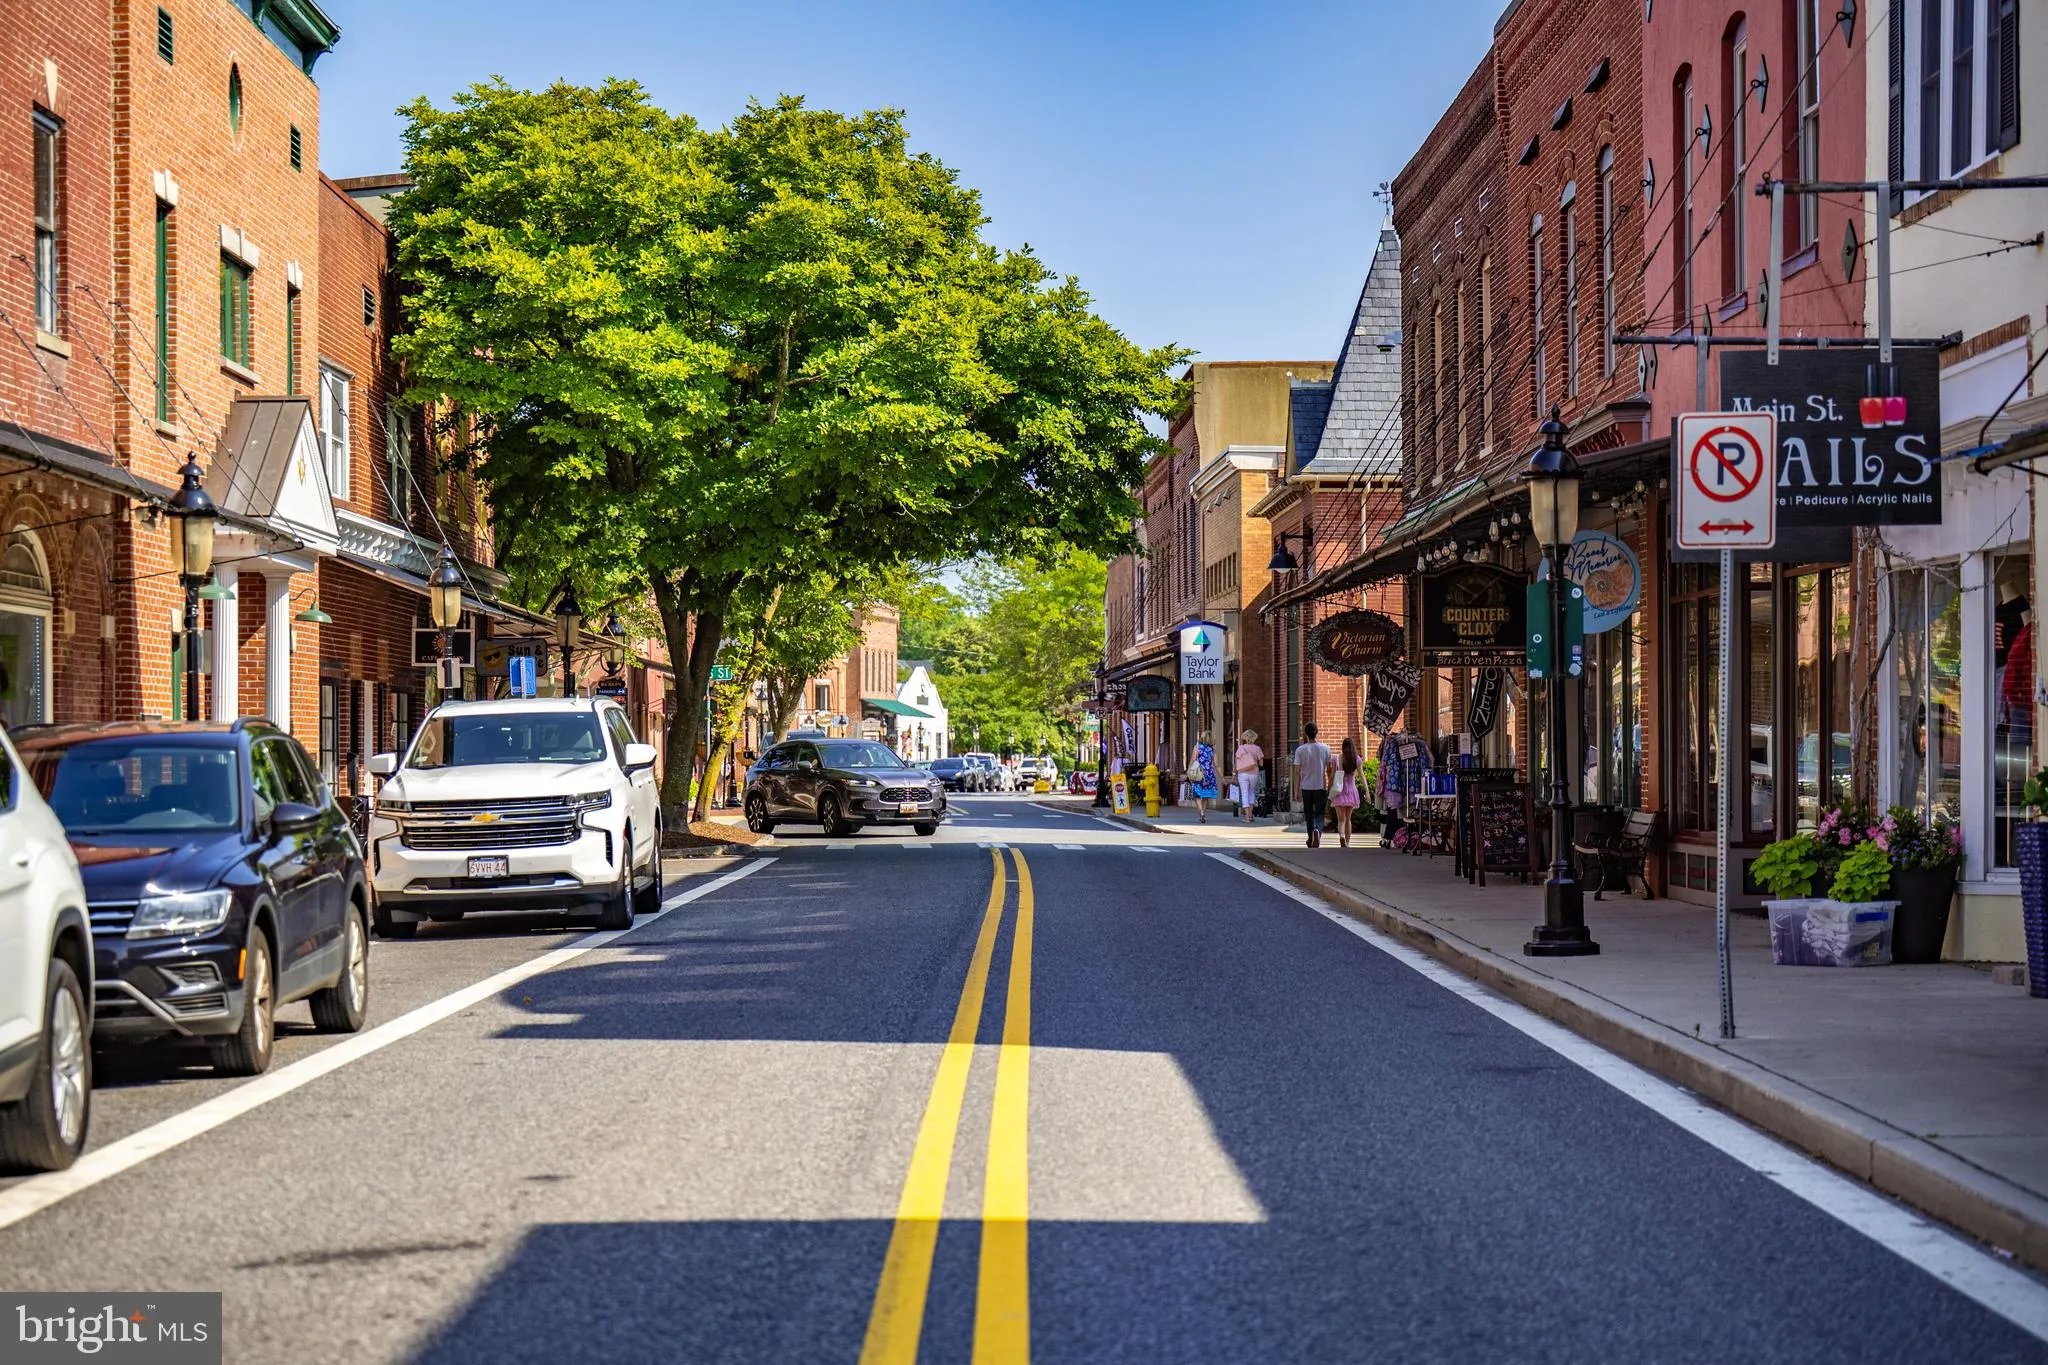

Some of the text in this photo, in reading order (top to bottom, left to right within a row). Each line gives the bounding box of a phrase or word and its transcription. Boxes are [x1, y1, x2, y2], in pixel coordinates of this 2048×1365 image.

[1805, 395, 1844, 422] St.
[1777, 434, 1932, 487] AILS
[1795, 495, 1849, 506] Pedicure
[1857, 494, 1898, 506] Acrylic
[1902, 494, 1933, 505] Nails
[1569, 536, 1609, 566] Beach
[1446, 608, 1505, 622] COUNTER
[1458, 622, 1494, 636] CLOX
[1330, 632, 1386, 650] Victorian
[508, 645, 543, 656] Sun &
[1341, 644, 1382, 659] Charm
[1185, 655, 1220, 670] Taylor
[1436, 656, 1523, 666] Brick Oven Pizza
[1188, 667, 1216, 679] Bank
[1473, 666, 1498, 727] OPEN
